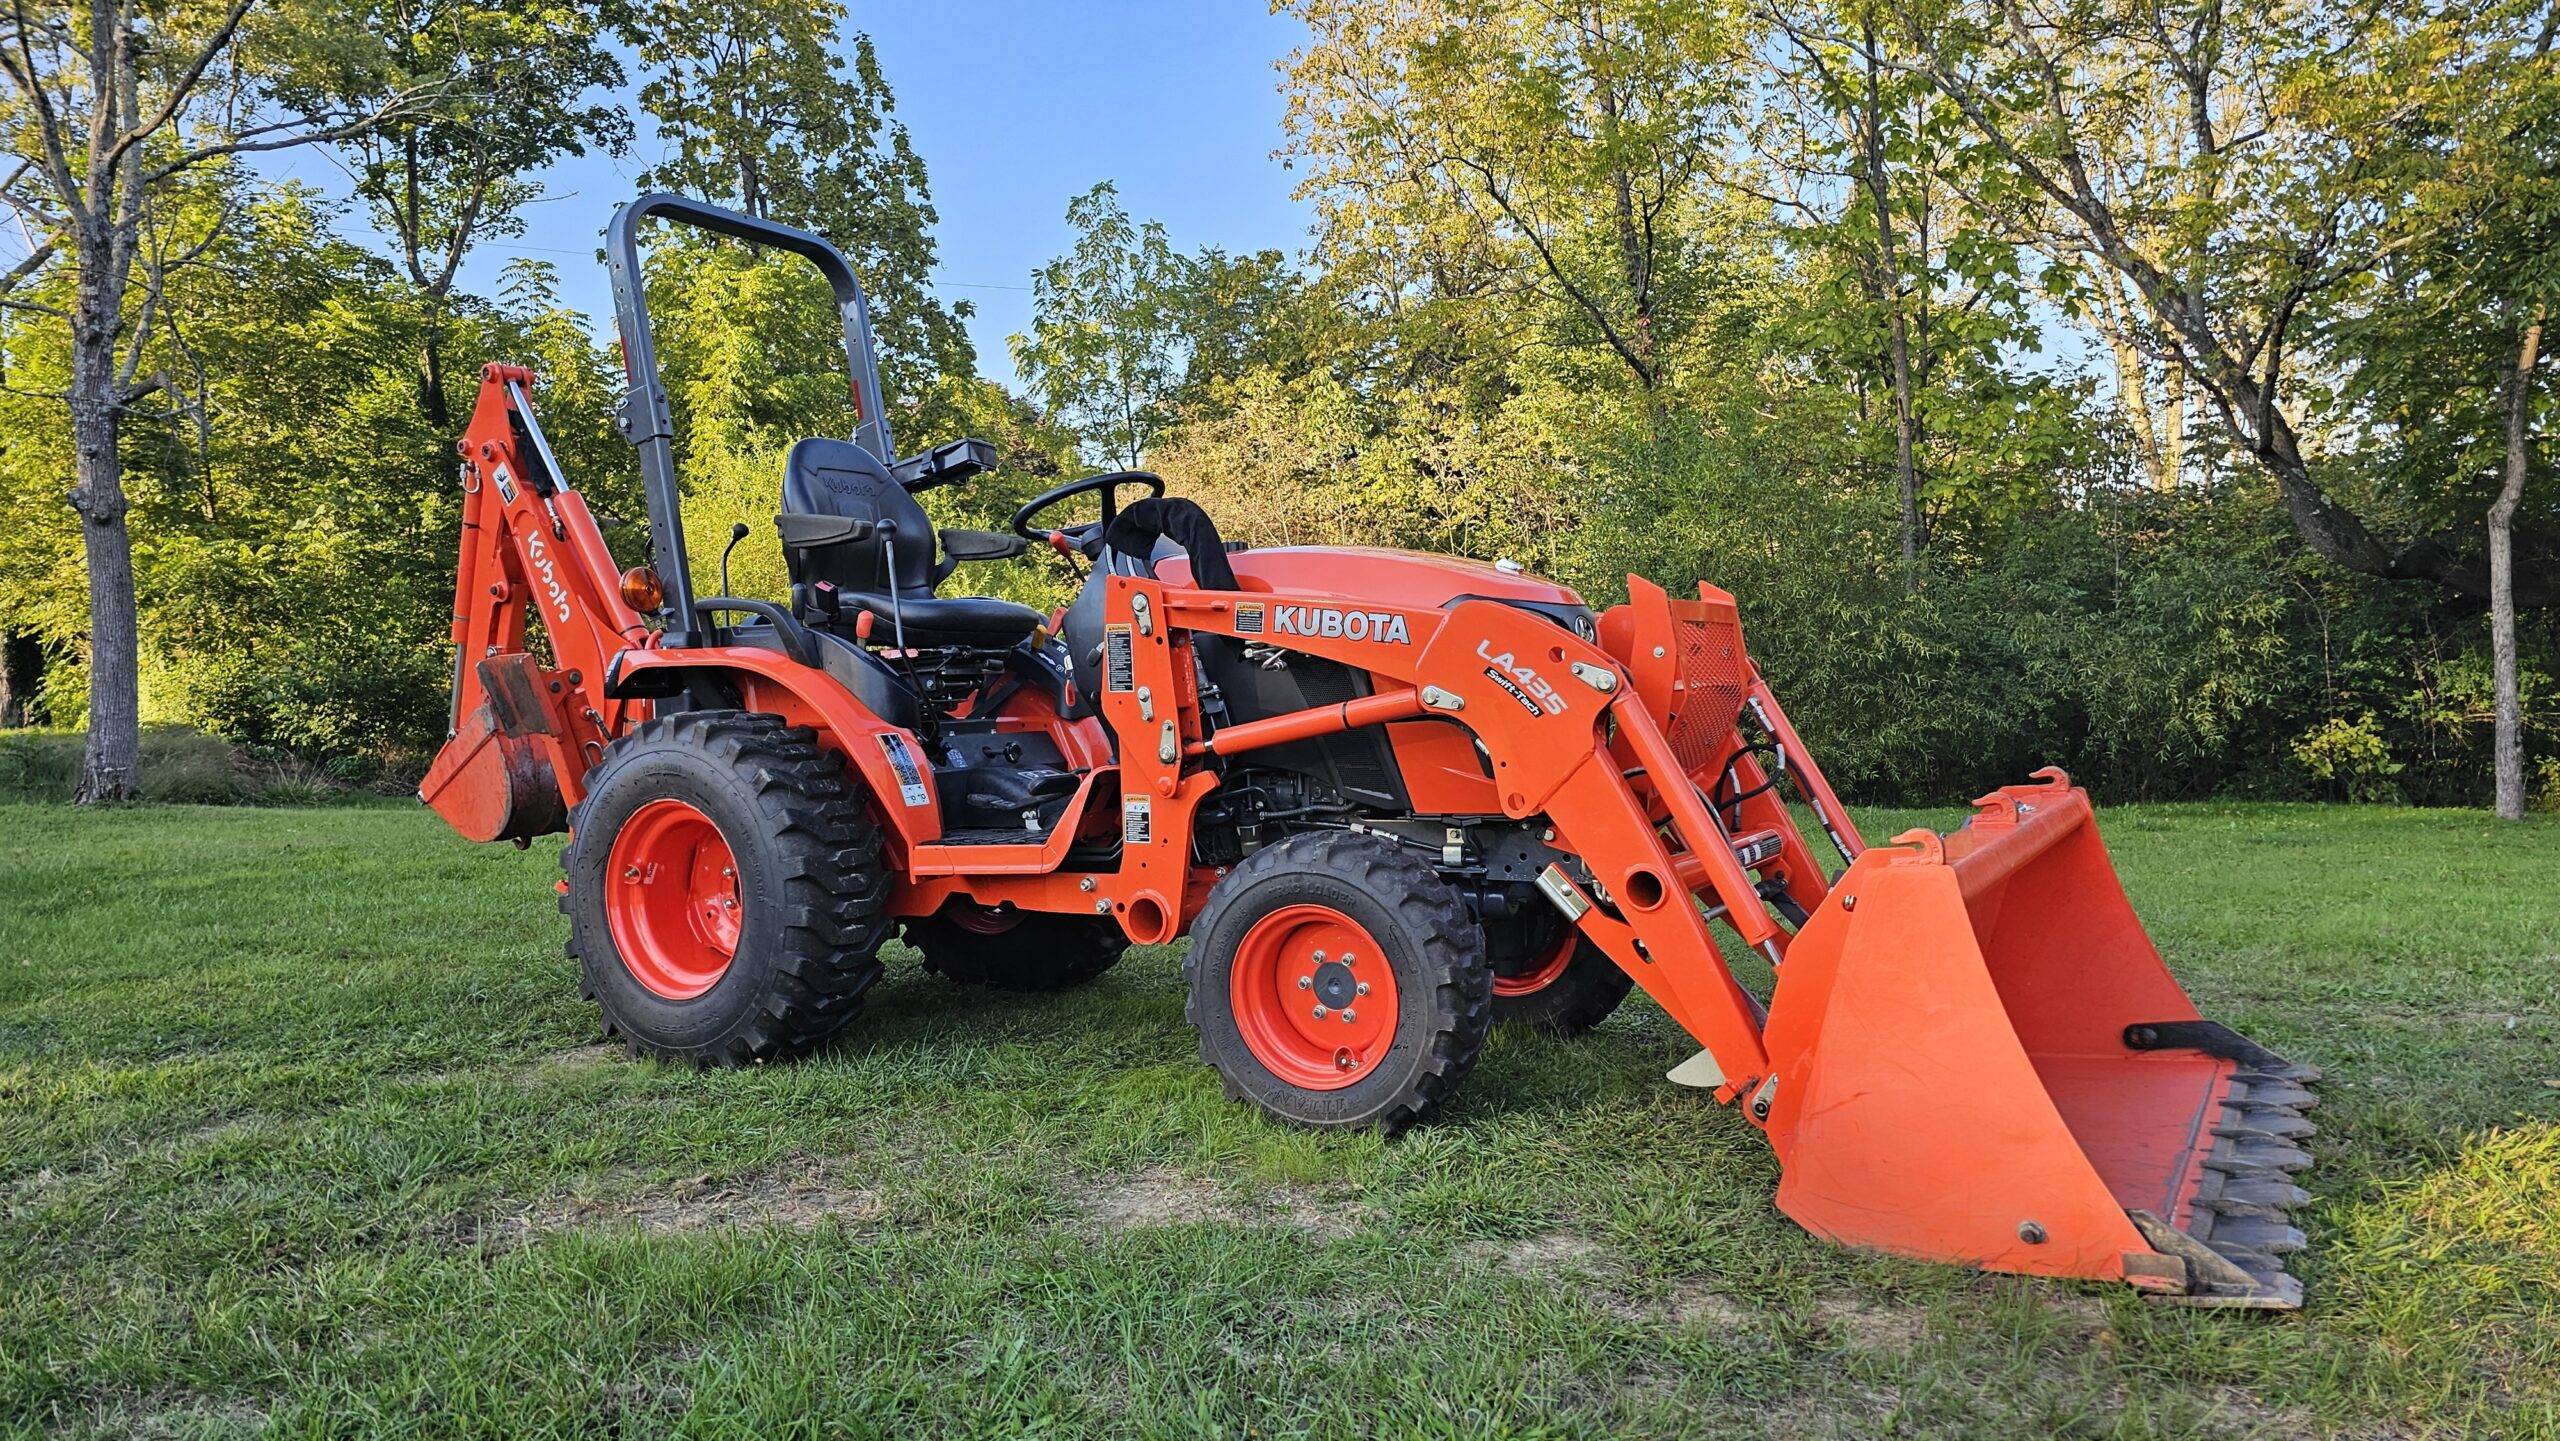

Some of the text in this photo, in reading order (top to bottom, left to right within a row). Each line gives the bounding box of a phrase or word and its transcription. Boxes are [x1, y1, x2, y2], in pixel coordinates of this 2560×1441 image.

[528, 530, 571, 624] Kubota
[1273, 605, 1411, 645] KUBOTA
[1476, 639, 1569, 716] LA435
[1486, 668, 1541, 716] Swift-Tech
[1306, 882, 1355, 907] LOADER
